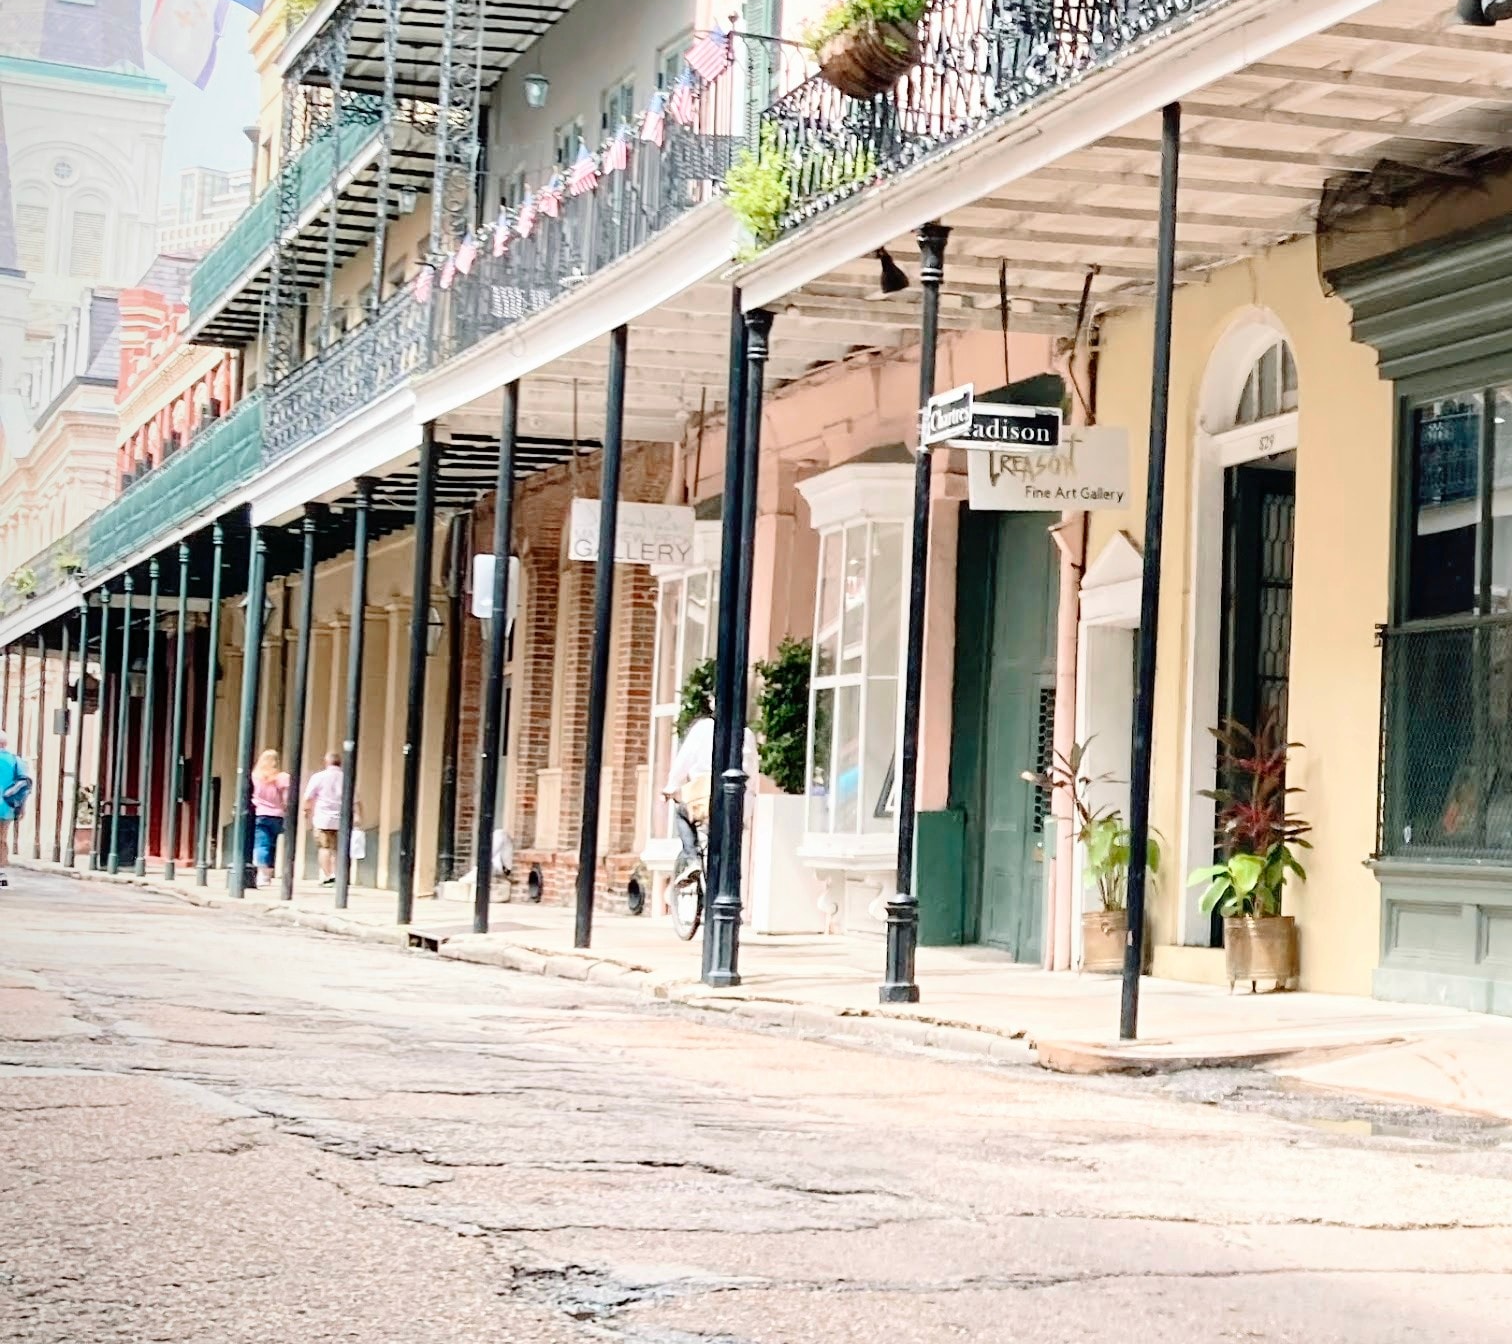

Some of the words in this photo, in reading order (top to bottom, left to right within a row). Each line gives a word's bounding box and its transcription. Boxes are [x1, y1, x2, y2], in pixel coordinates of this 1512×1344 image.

[930, 407, 971, 432] Chartres
[965, 418, 1050, 442] adison
[1025, 485, 1051, 499] Fine
[1055, 487, 1077, 500] Art
[1081, 487, 1124, 503] Gallery
